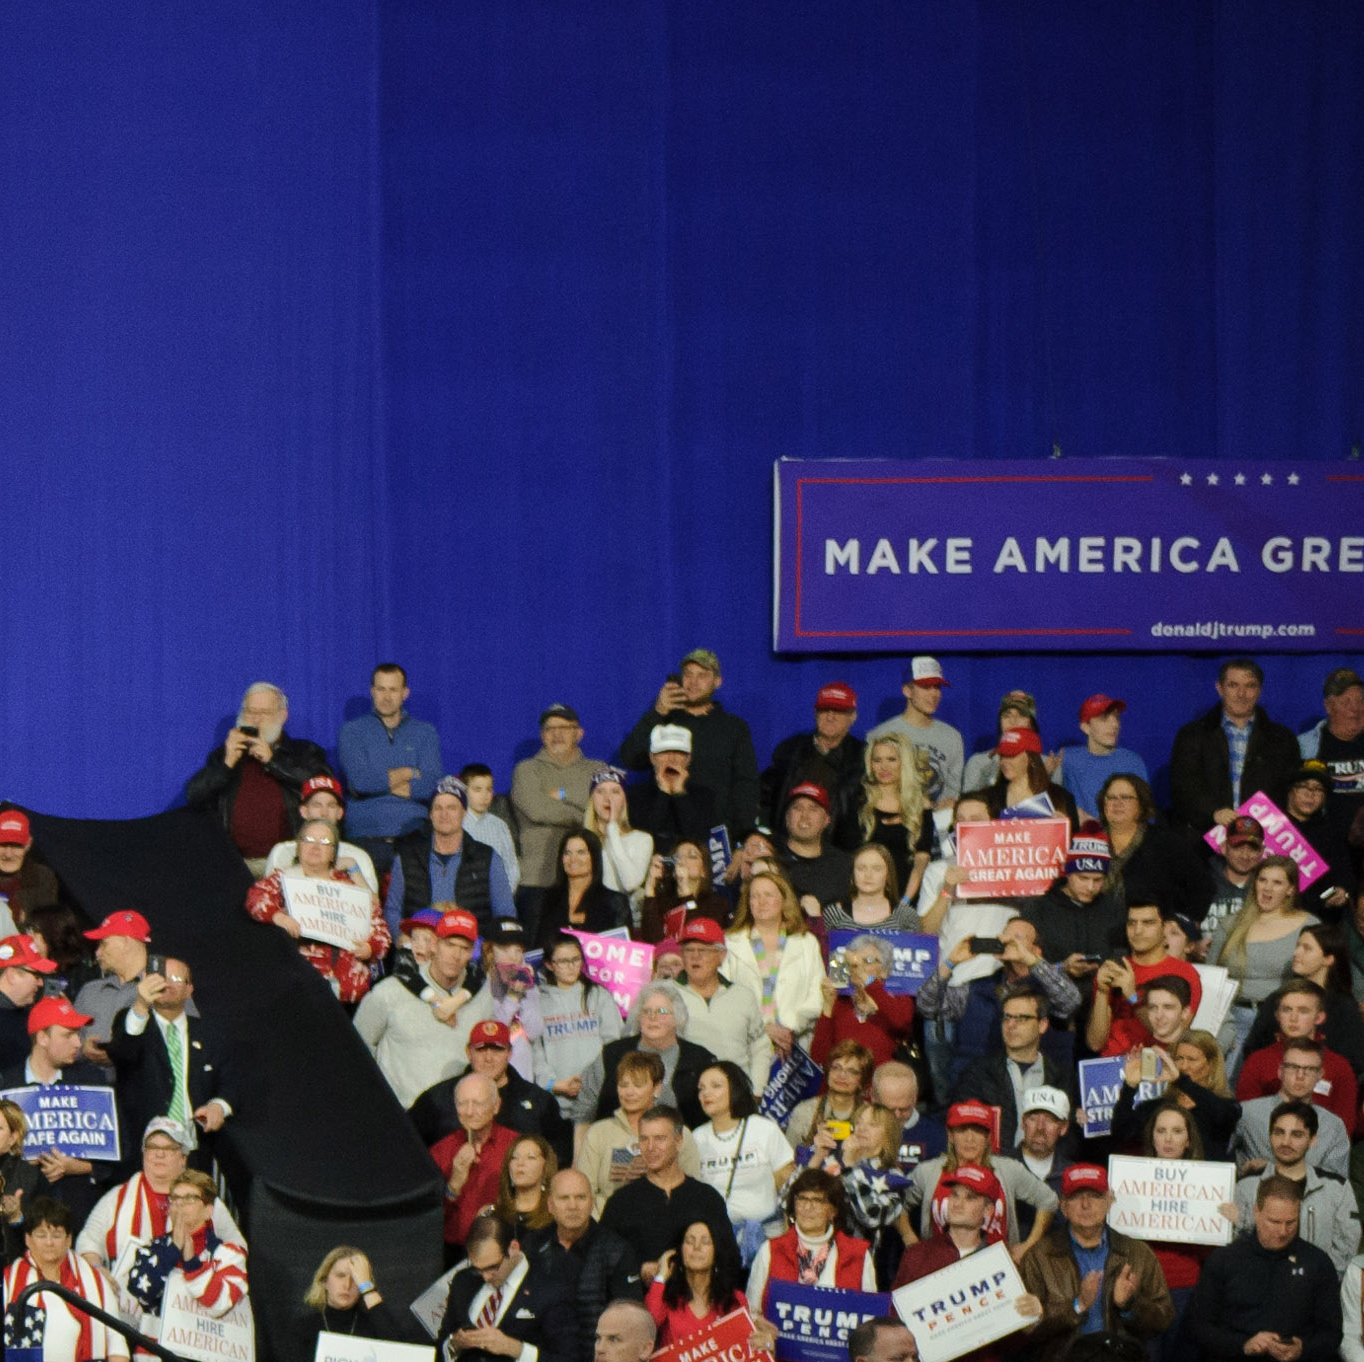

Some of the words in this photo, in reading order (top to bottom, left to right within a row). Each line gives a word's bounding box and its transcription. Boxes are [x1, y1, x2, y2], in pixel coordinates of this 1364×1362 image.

[824, 537, 973, 575] MAKE
[993, 536, 1240, 574] AMERICA
[1261, 536, 1364, 573] GRE
[1150, 621, 1316, 640] donaldjtrump.com
[994, 832, 1031, 844] MAKE
[961, 846, 1066, 867] AMERICA
[1076, 859, 1104, 871] USA
[970, 868, 1011, 882] GREAT
[1014, 867, 1059, 881] AGAIN
[317, 884, 340, 898] BUY
[294, 892, 367, 919] AMERICAN
[320, 909, 347, 925] HIRE
[585, 940, 645, 967] OME
[589, 965, 625, 984] FOR
[547, 1020, 598, 1037] TRUMP
[39, 1096, 78, 1108] MAKE
[1032, 1093, 1056, 1104] USA
[1086, 1082, 1169, 1106] AMRI
[24, 1110, 115, 1131] MERICA
[1088, 1107, 1114, 1123] STR
[26, 1131, 55, 1145] AFE
[59, 1131, 106, 1146] AGAIN
[1154, 1167, 1188, 1181] BUY
[1118, 1179, 1224, 1200] AMERICAN
[1152, 1200, 1189, 1214] HIRE
[1114, 1211, 1223, 1233] AMERICAN
[912, 1271, 1007, 1322] TRUMP
[775, 1301, 874, 1330] TRUM
[928, 1289, 1007, 1332] PENCE
[197, 1318, 225, 1338] HIRE
[783, 1320, 848, 1340] PENC
[167, 1328, 248, 1362] AMERICAN
